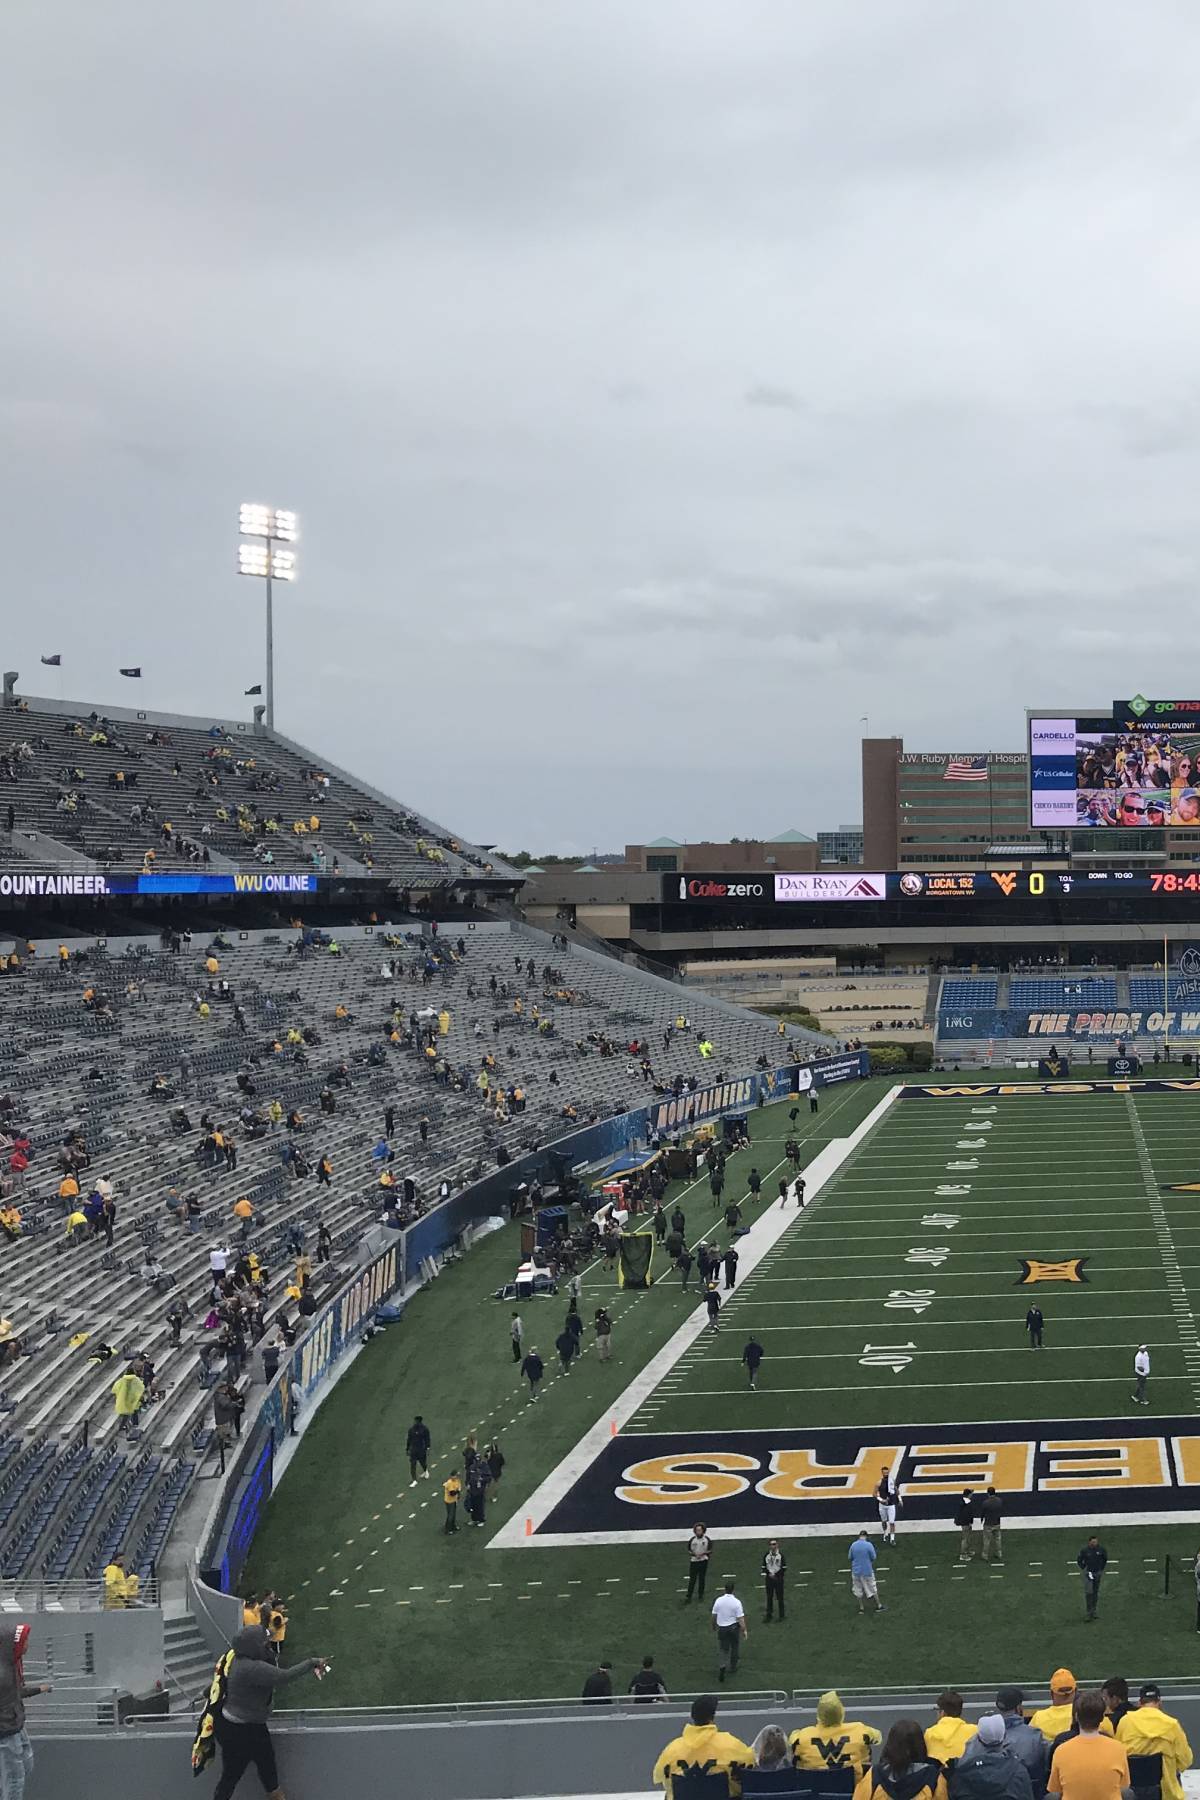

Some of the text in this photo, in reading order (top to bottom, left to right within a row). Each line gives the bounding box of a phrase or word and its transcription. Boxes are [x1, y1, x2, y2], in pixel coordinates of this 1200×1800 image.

[922, 754, 947, 765] Ruby
[949, 754, 993, 763] Memorl
[234, 875, 310, 892] WVU ONLINE
[778, 877, 848, 890] DAN RYAN
[928, 877, 974, 889] LOCAL 152
[1028, 872, 1044, 895] 0
[1062, 883, 1071, 893] 3
[945, 1016, 973, 1028] IMG
[1027, 1013, 1071, 1033] THE
[1073, 1012, 1140, 1034] PRIDE
[1146, 1012, 1176, 1031] OF
[921, 1083, 1146, 1096] WEST
[904, 1247, 951, 1263] 30
[883, 1289, 936, 1309] 20
[858, 1341, 917, 1367] 10
